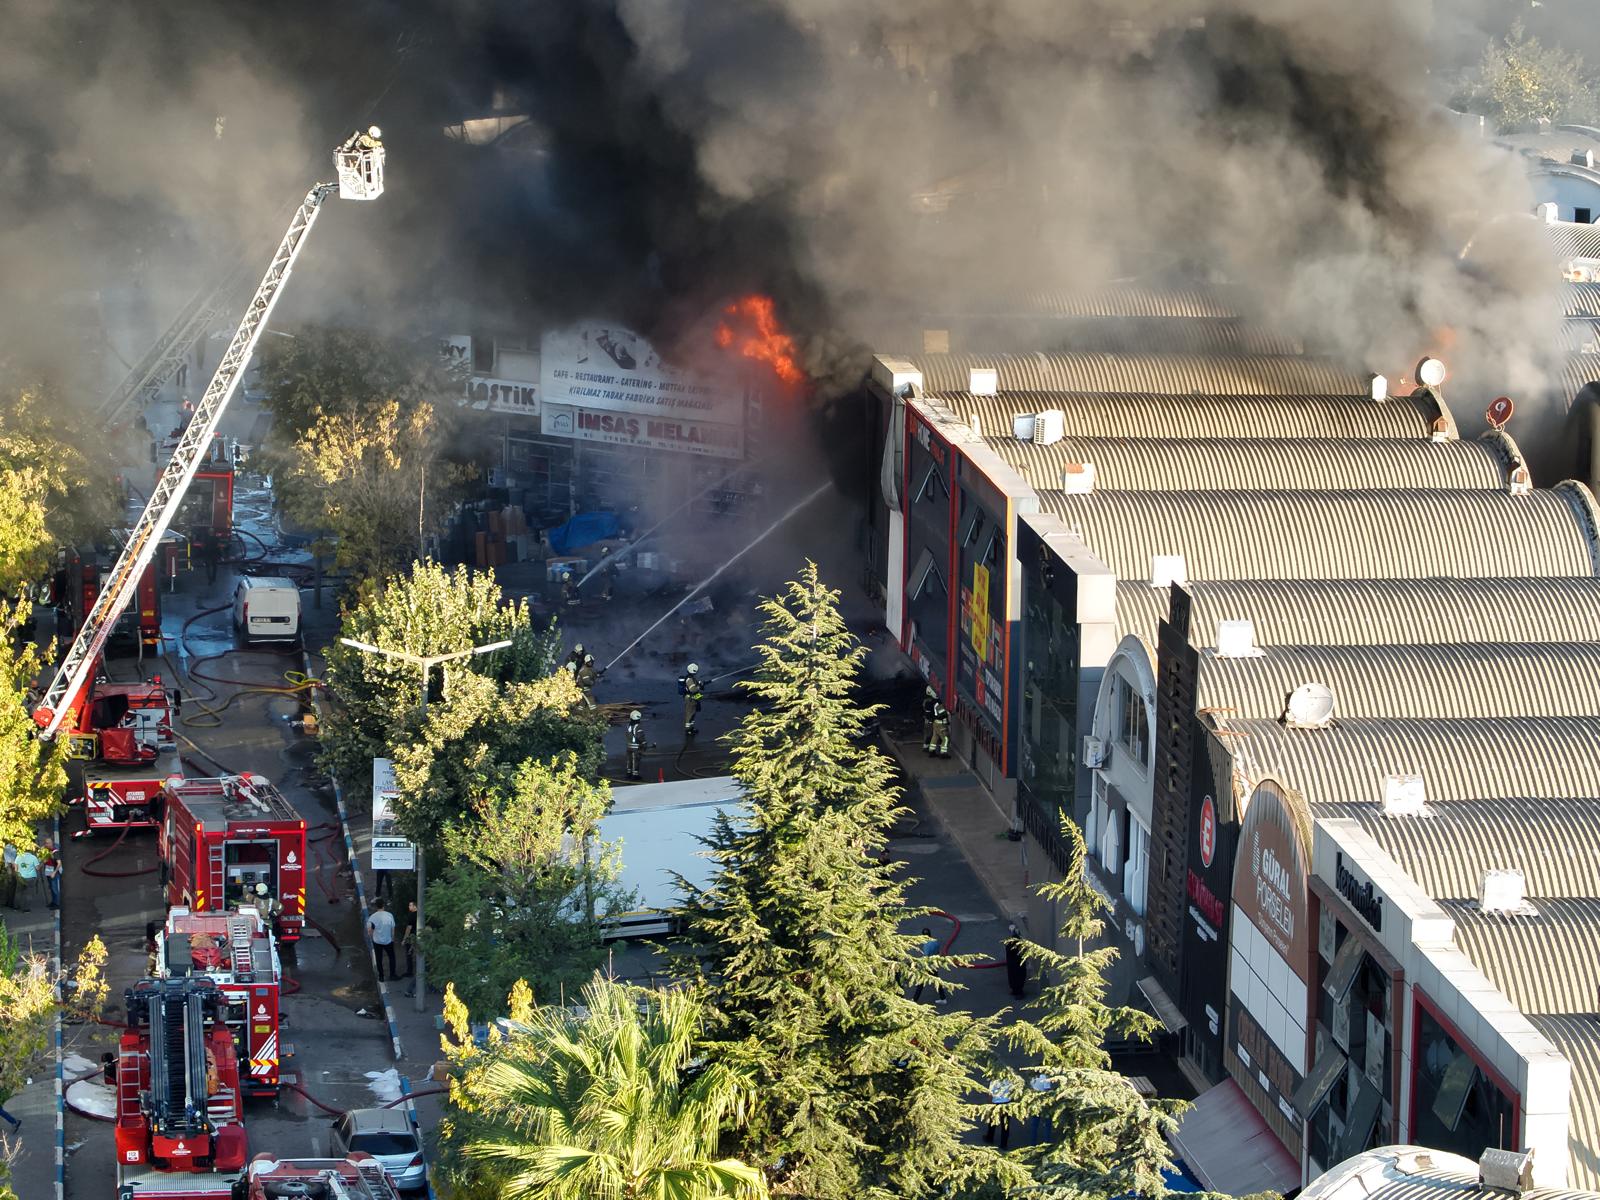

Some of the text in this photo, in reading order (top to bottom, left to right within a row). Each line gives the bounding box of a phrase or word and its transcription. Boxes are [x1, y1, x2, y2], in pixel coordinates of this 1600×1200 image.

[553, 369, 569, 379] CAFE
[575, 372, 615, 385] RESTAURANT
[1262, 847, 1291, 901] GÜRAL
[1256, 874, 1295, 940] PORSELEN
